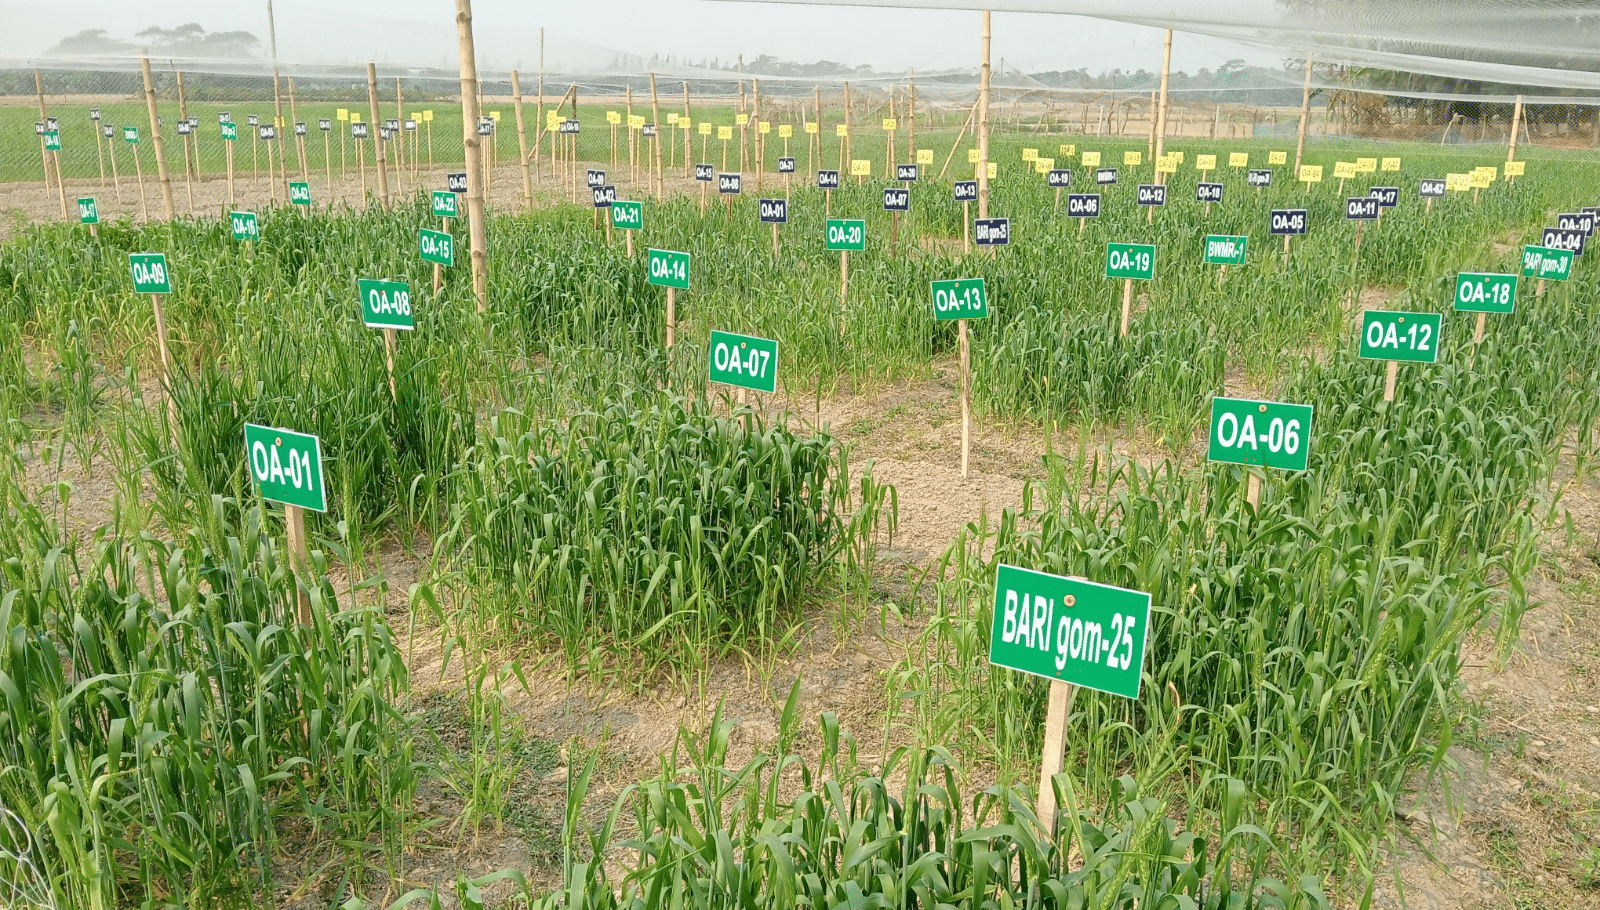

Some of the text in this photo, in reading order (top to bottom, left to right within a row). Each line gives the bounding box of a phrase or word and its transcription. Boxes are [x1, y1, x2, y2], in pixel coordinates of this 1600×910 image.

[696, 167, 712, 178] OA-15
[819, 174, 837, 185] OA-14
[898, 169, 915, 178] OA-20
[1050, 173, 1068, 184] OA-19
[449, 178, 466, 189] OA-03
[720, 178, 738, 190] OA-08
[955, 185, 975, 196] OA-13
[1422, 182, 1444, 195] OA-62
[594, 190, 614, 203] OA-02
[885, 193, 906, 206] OA-07
[1140, 190, 1163, 202] OA-12
[1198, 186, 1220, 198] OA-18
[1371, 192, 1396, 203] OA-17
[80, 204, 95, 219] OA-17
[434, 197, 454, 212] OA-22
[760, 204, 784, 217] OA-01
[1070, 199, 1097, 213] OA-06
[1349, 202, 1376, 215] OA-11
[614, 207, 639, 222] OA-21
[233, 217, 256, 235] OA-16
[1272, 215, 1304, 230] OA-05
[1560, 218, 1592, 232] OA-10
[829, 226, 860, 244] OA-20
[1544, 232, 1581, 250] OA-04
[422, 236, 449, 258] OA-15
[1207, 241, 1244, 259] BWMRI-1
[652, 257, 686, 280] OA-14
[1109, 250, 1150, 272] OA-19
[133, 262, 165, 284] OA-09
[1459, 280, 1510, 304] OA-18
[370, 289, 410, 316] OA-08
[936, 288, 982, 312] OA-13
[1366, 320, 1432, 352] OA-12
[714, 342, 770, 378] OA-07
[1217, 412, 1300, 455] OA-06
[252, 440, 312, 491] OA-01
[1002, 588, 1136, 671] BARI gom-25
